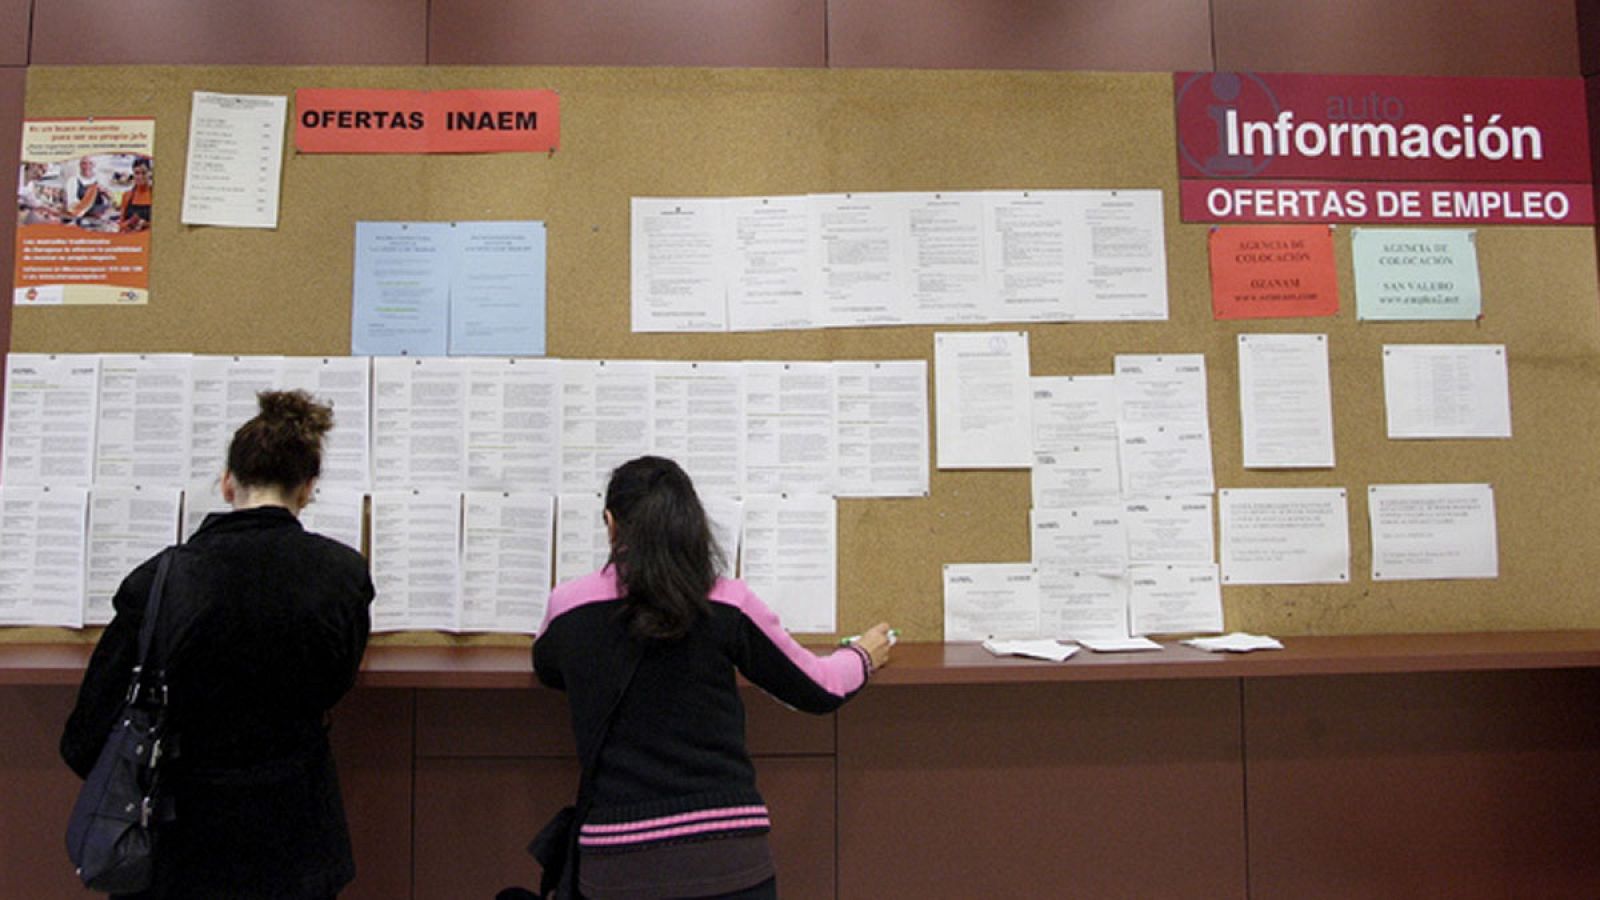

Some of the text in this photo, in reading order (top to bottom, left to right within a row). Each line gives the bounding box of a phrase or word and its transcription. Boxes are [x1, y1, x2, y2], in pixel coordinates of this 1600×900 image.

[1328, 94, 1405, 121] auto
[301, 109, 537, 130] OFERTAS INAEM
[1226, 110, 1543, 160] Información
[1207, 187, 1570, 220] OFERTAS DE EMPLEO
[1239, 240, 1304, 250] AGENCIA DE
[1383, 243, 1447, 253] AGENCIA DE
[1235, 252, 1310, 263] COLOCACIÓN
[1379, 255, 1453, 265] COLOCACIÓN
[1250, 278, 1300, 288] OZANAM
[1383, 281, 1454, 291] SAN VALERO
